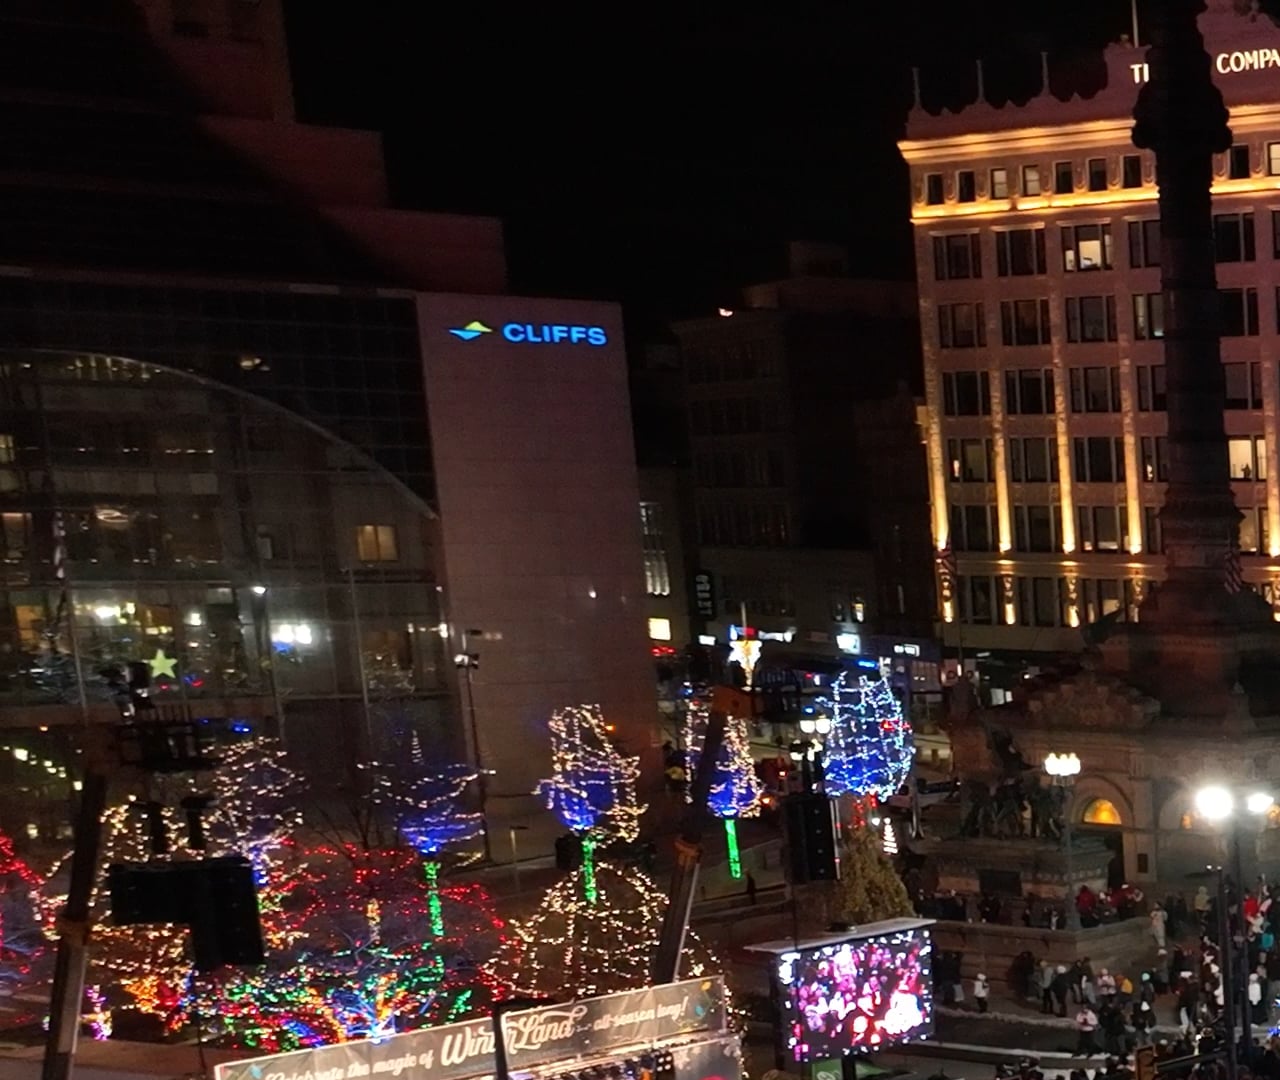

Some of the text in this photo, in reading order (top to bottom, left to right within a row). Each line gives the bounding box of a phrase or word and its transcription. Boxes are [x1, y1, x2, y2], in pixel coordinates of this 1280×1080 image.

[502, 323, 607, 346] CLIFFS
[347, 1060, 371, 1078] the
[372, 1052, 417, 1076] magic
[419, 1049, 434, 1069] of
[440, 1004, 588, 1066] WintrLand
